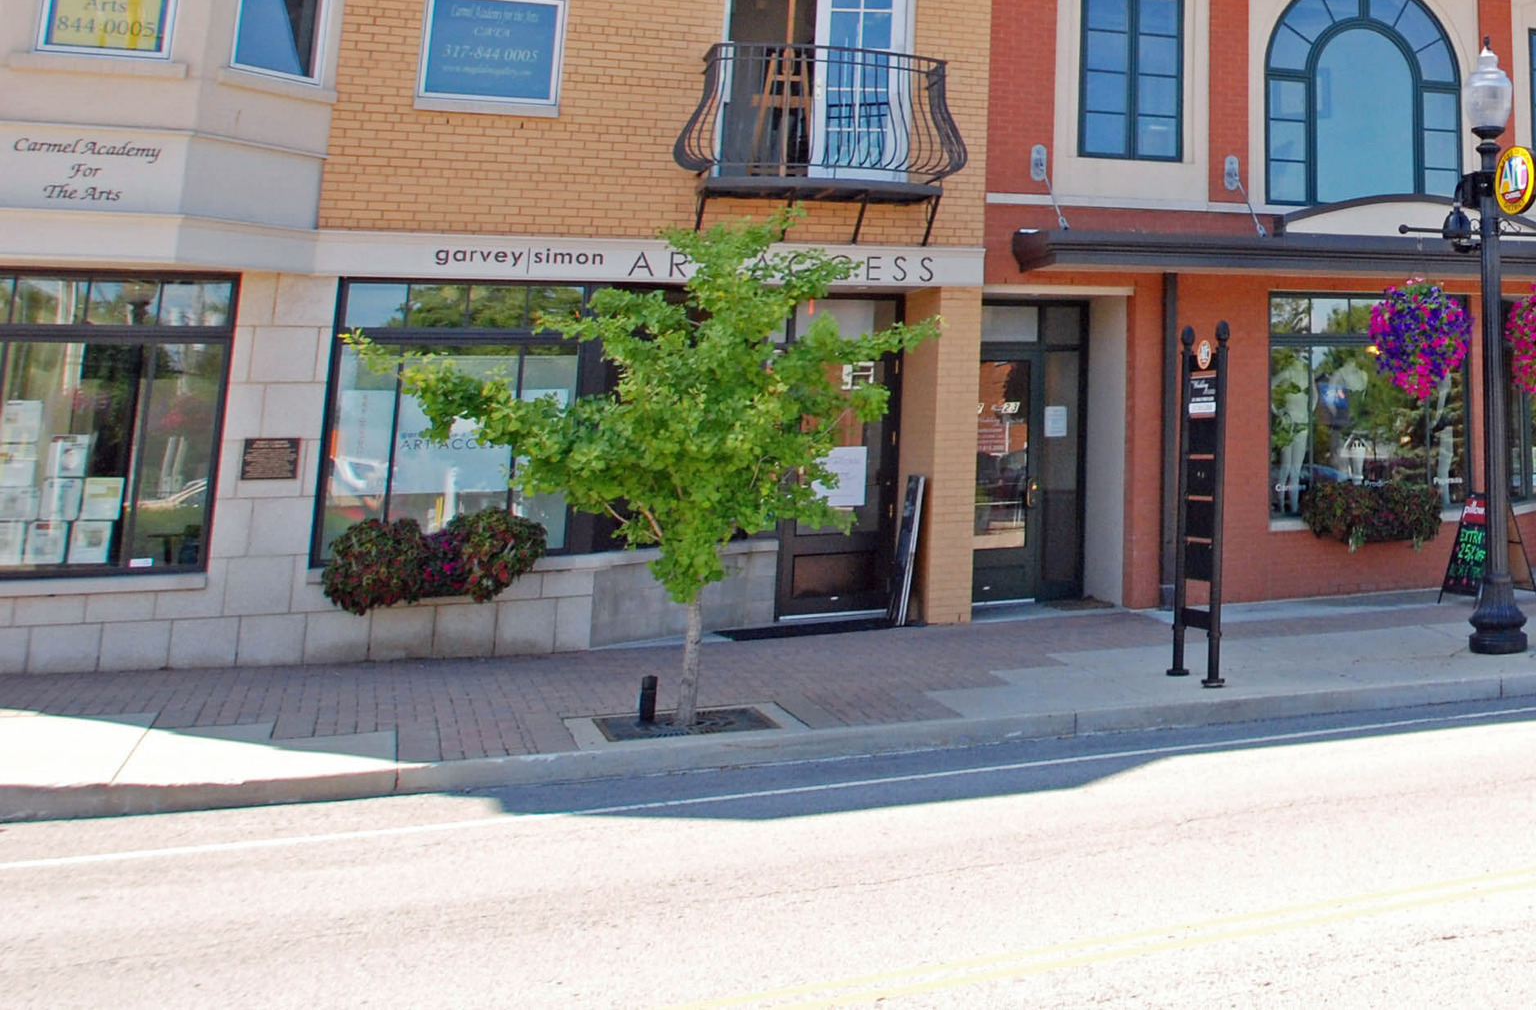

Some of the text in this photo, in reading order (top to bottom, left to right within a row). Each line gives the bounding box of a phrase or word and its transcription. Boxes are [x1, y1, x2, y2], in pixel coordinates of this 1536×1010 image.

[57, 15, 155, 38] 844 0005
[14, 137, 162, 164] Carmel Academy
[68, 163, 103, 179] For
[43, 183, 123, 202] The Arts
[628, 251, 705, 279] AR
